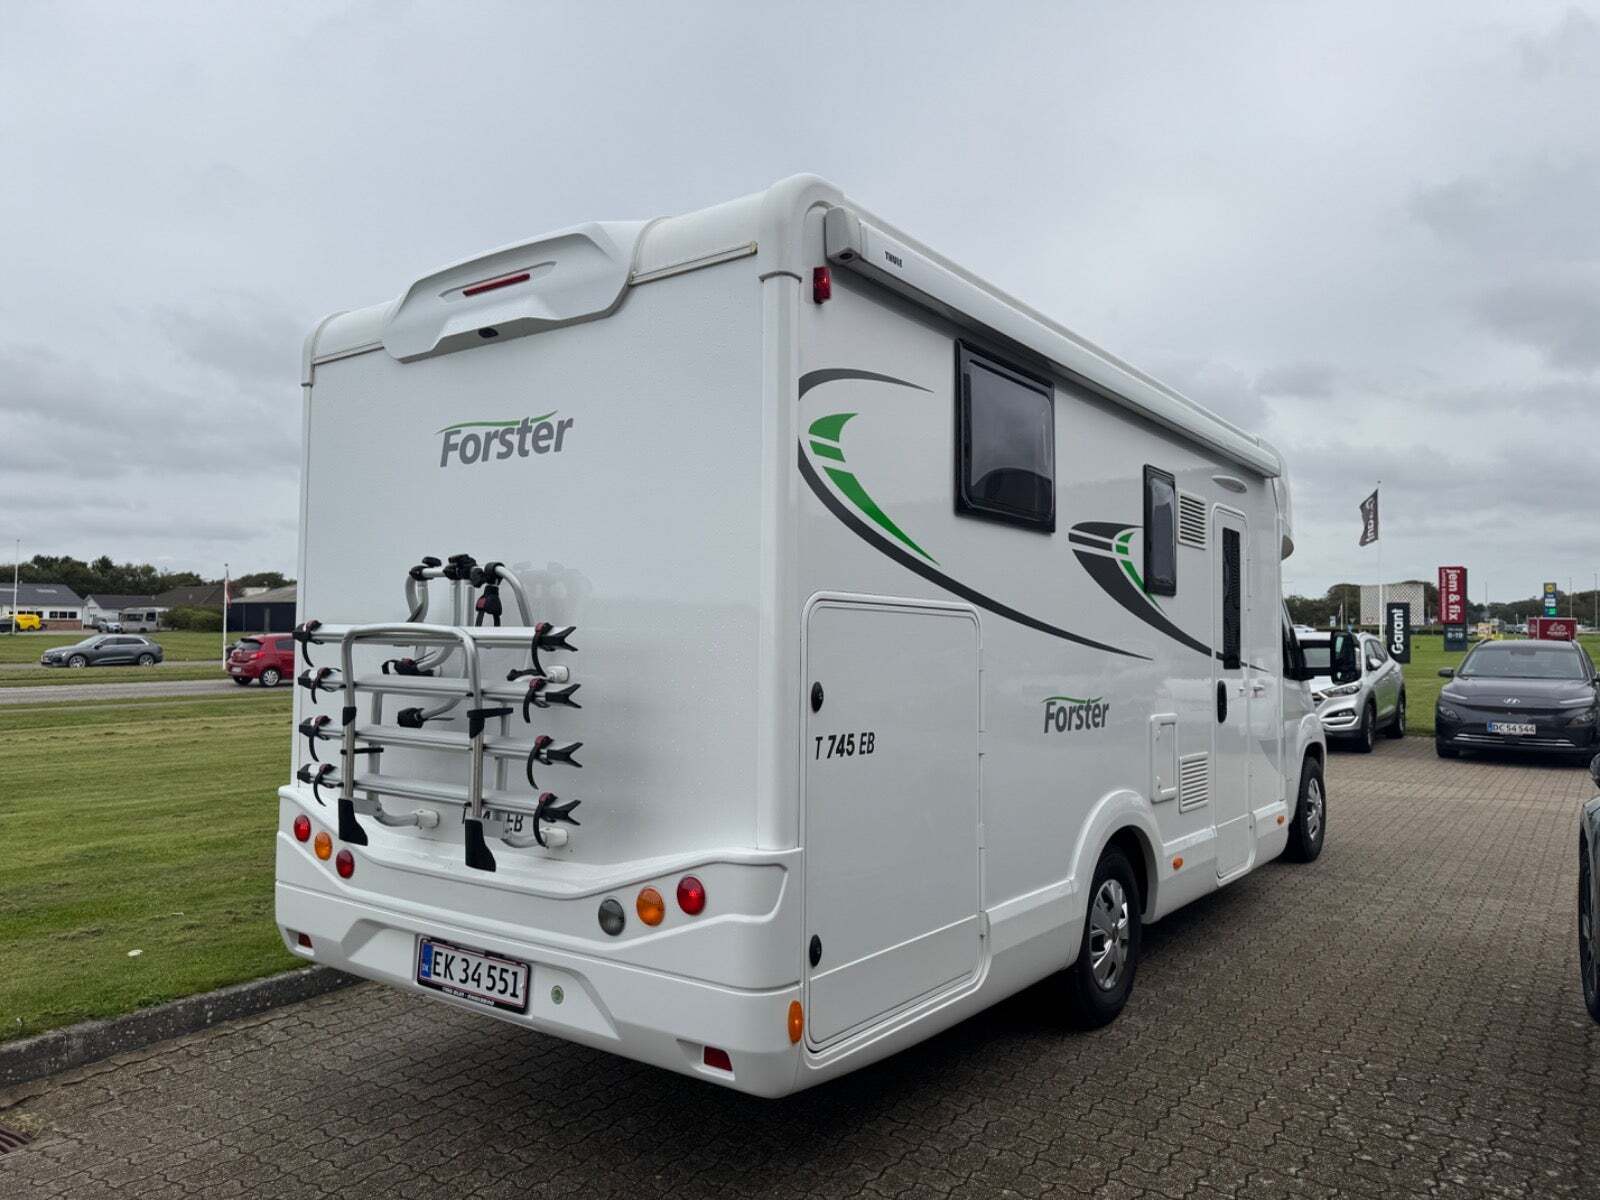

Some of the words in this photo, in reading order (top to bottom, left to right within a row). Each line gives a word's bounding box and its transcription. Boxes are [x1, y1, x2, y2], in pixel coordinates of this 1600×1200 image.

[884, 250, 903, 268] THULE
[440, 416, 574, 468] Forster
[1447, 605, 1461, 621] fix
[1448, 593, 1461, 604] &
[1391, 608, 1404, 654] Garant
[1043, 698, 1110, 734] Forster
[814, 736, 823, 760] T
[827, 733, 855, 759] 745
[858, 731, 876, 756] EB
[433, 951, 456, 981] EK
[458, 958, 482, 988] 34
[485, 964, 519, 999] 551
